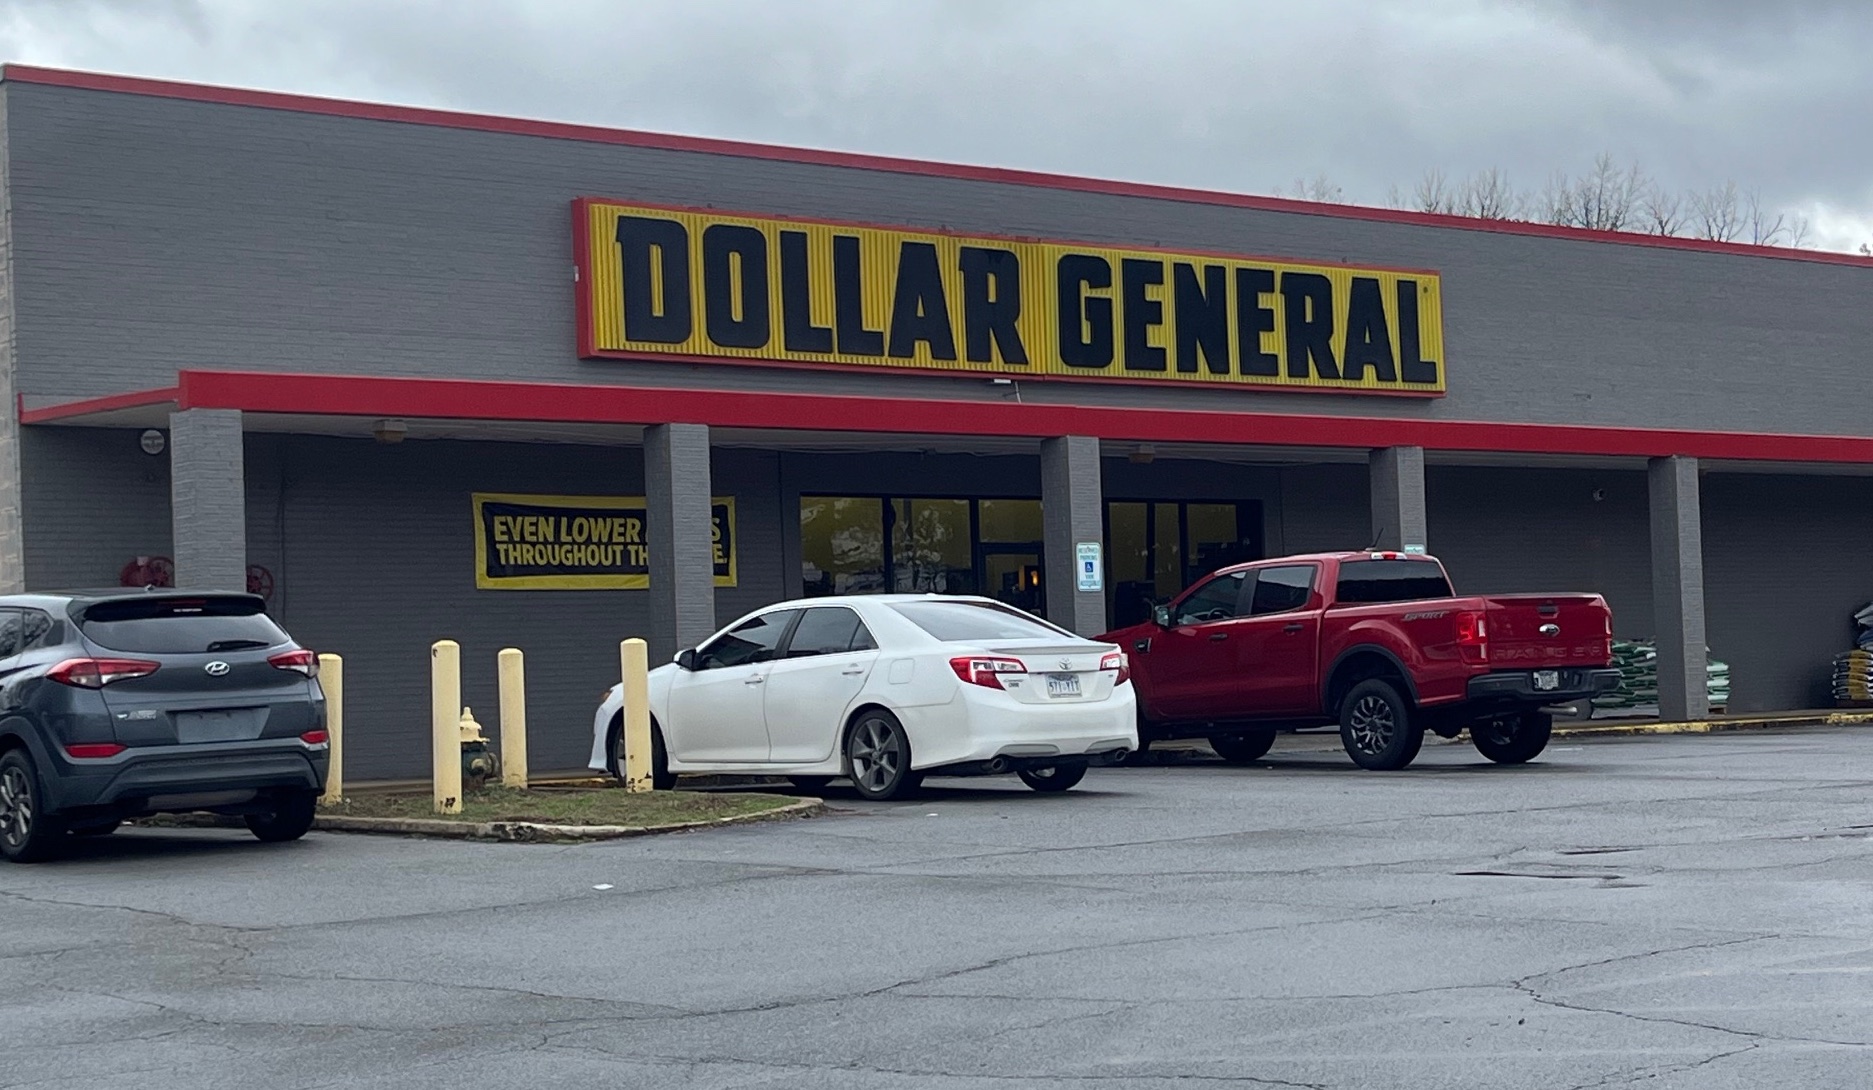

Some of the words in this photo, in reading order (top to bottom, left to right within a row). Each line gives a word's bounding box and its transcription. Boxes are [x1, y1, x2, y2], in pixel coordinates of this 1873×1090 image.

[616, 215, 1028, 365] DOLLAR
[1057, 254, 1437, 383] GENERAL
[493, 515, 555, 542] EVEN
[560, 517, 641, 543] LOWER
[496, 543, 623, 566] THROUGHOUT
[629, 544, 649, 566] TH
